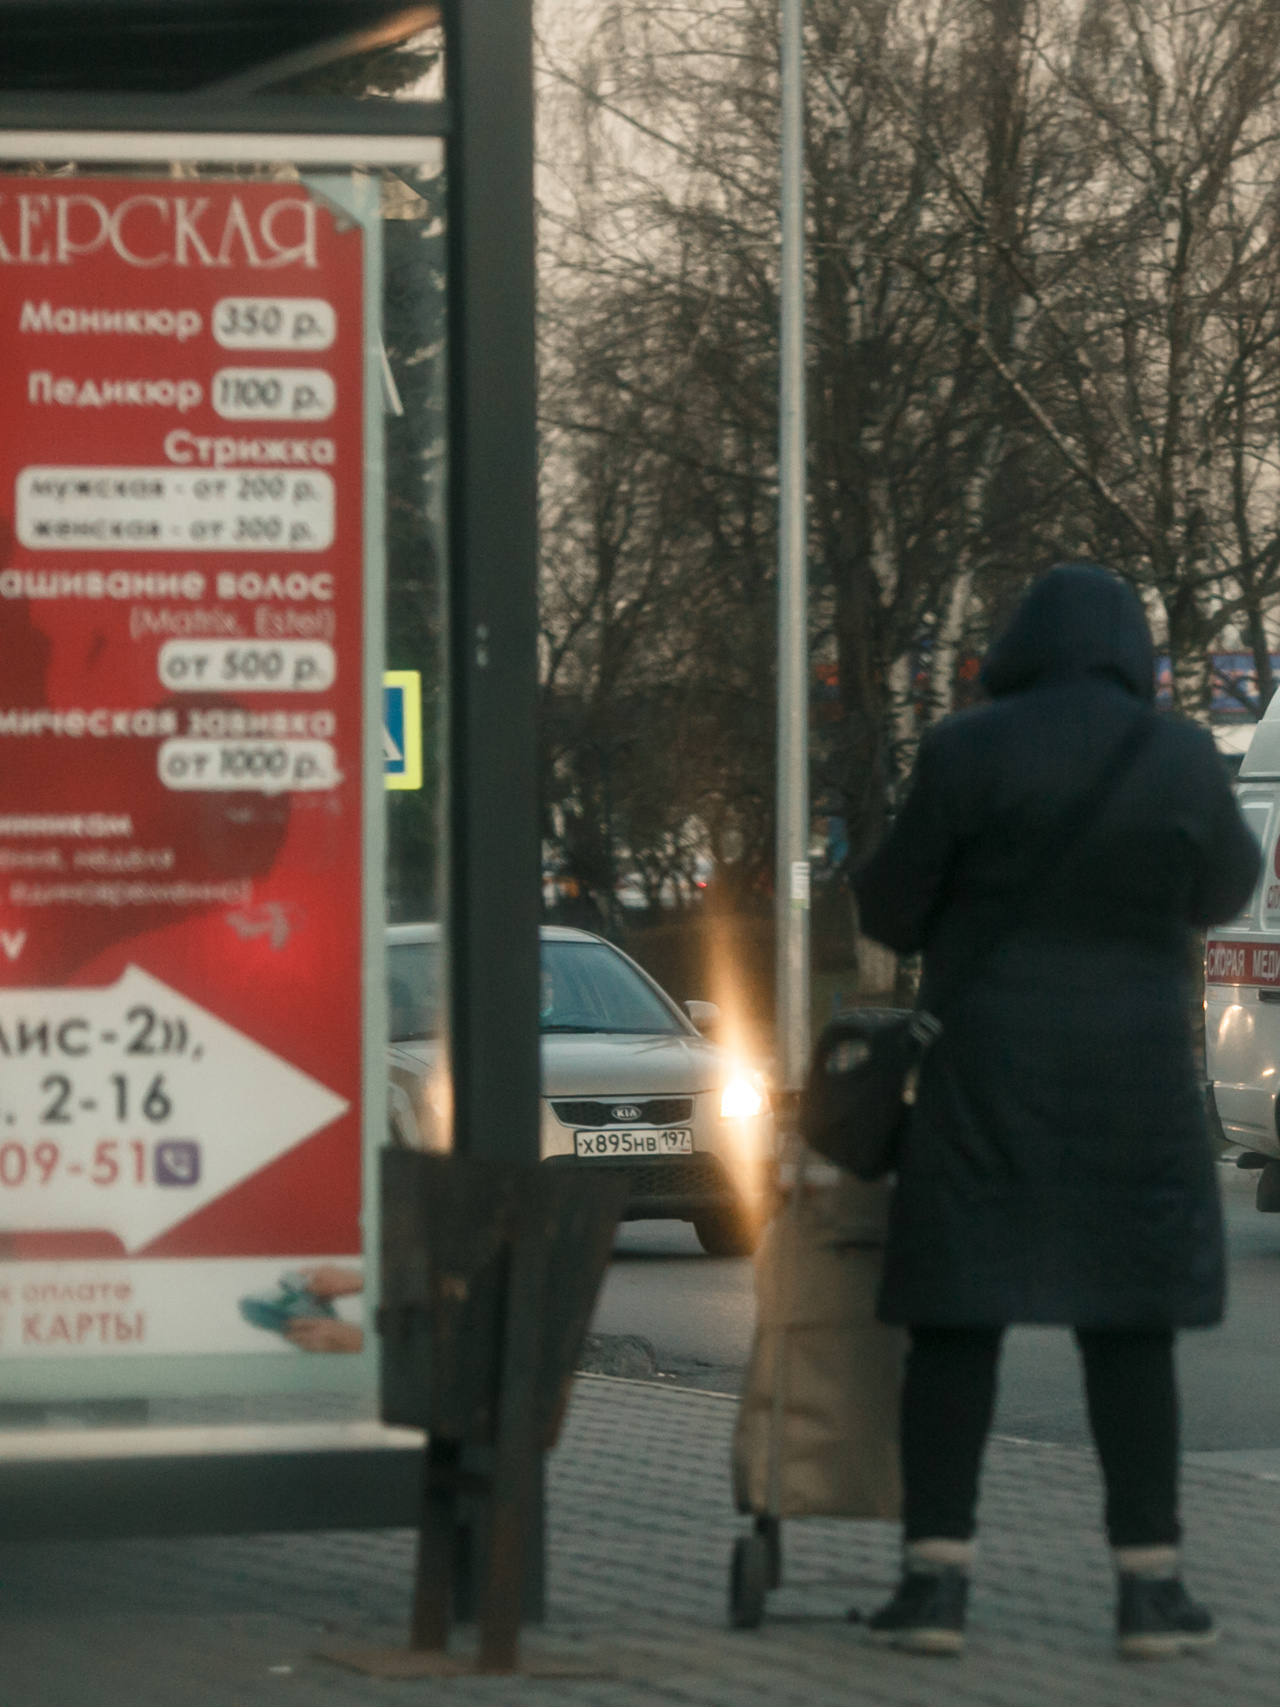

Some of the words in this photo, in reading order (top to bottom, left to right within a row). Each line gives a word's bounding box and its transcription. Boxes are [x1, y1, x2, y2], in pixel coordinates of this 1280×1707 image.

[0, 195, 318, 267] ЕРСКАЯ
[20, 301, 202, 342] Маникюр
[220, 306, 282, 335] 350
[293, 312, 323, 342] р.
[28, 371, 202, 413] Педикюр
[220, 378, 282, 406] 1100
[293, 383, 323, 412] р.
[164, 430, 334, 469] Стрижка
[30, 479, 164, 504] мужская
[194, 480, 226, 500] от
[33, 519, 161, 541] женская
[189, 520, 223, 541] от
[216, 571, 334, 600] волос
[167, 655, 207, 679] от
[221, 651, 283, 679] 500
[294, 657, 323, 686] р.
[189, 710, 336, 737] завивка
[167, 753, 208, 778] от
[220, 749, 289, 777] 1000
[293, 754, 324, 786] р.
[1208, 948, 1245, 977] СКОРАЯ
[40, 1072, 172, 1124] 2-16
[616, 1109, 637, 1117] KIA
[583, 1133, 656, 1154] Х895НВ
[661, 1131, 686, 1146] 197
[23, 1281, 132, 1303] оплате
[23, 1310, 145, 1344] КАРТЫ
